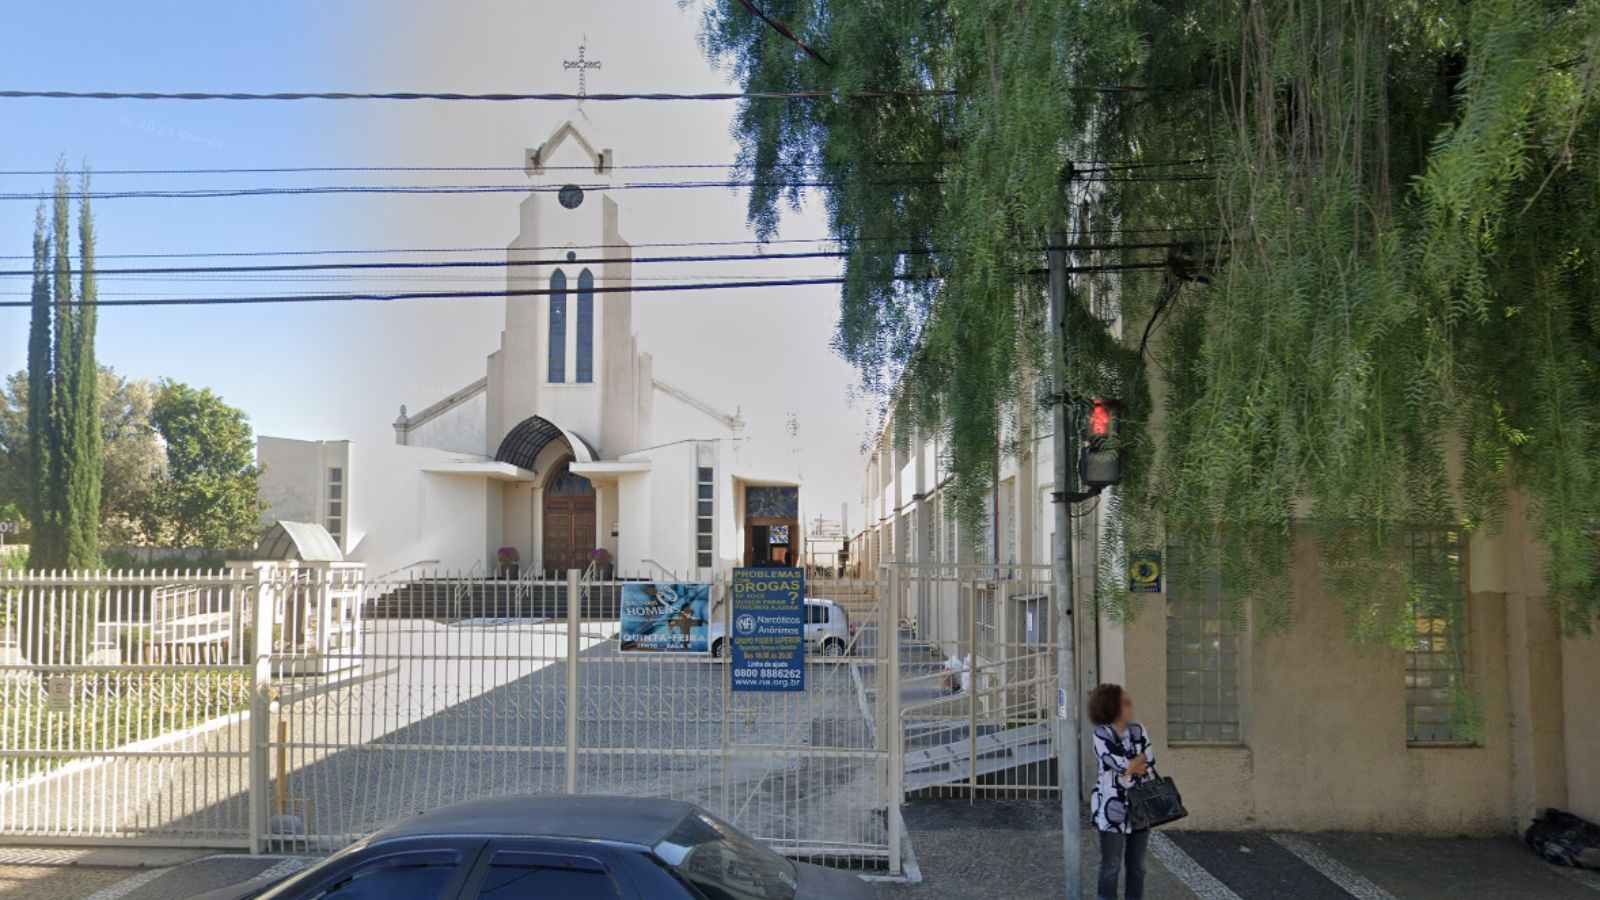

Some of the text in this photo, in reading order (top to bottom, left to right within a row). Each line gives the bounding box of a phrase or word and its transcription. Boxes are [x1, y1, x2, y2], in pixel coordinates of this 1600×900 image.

[736, 570, 801, 578] PROBLEMAS
[735, 581, 800, 593] DROGAS
[734, 669, 758, 679] 0800
